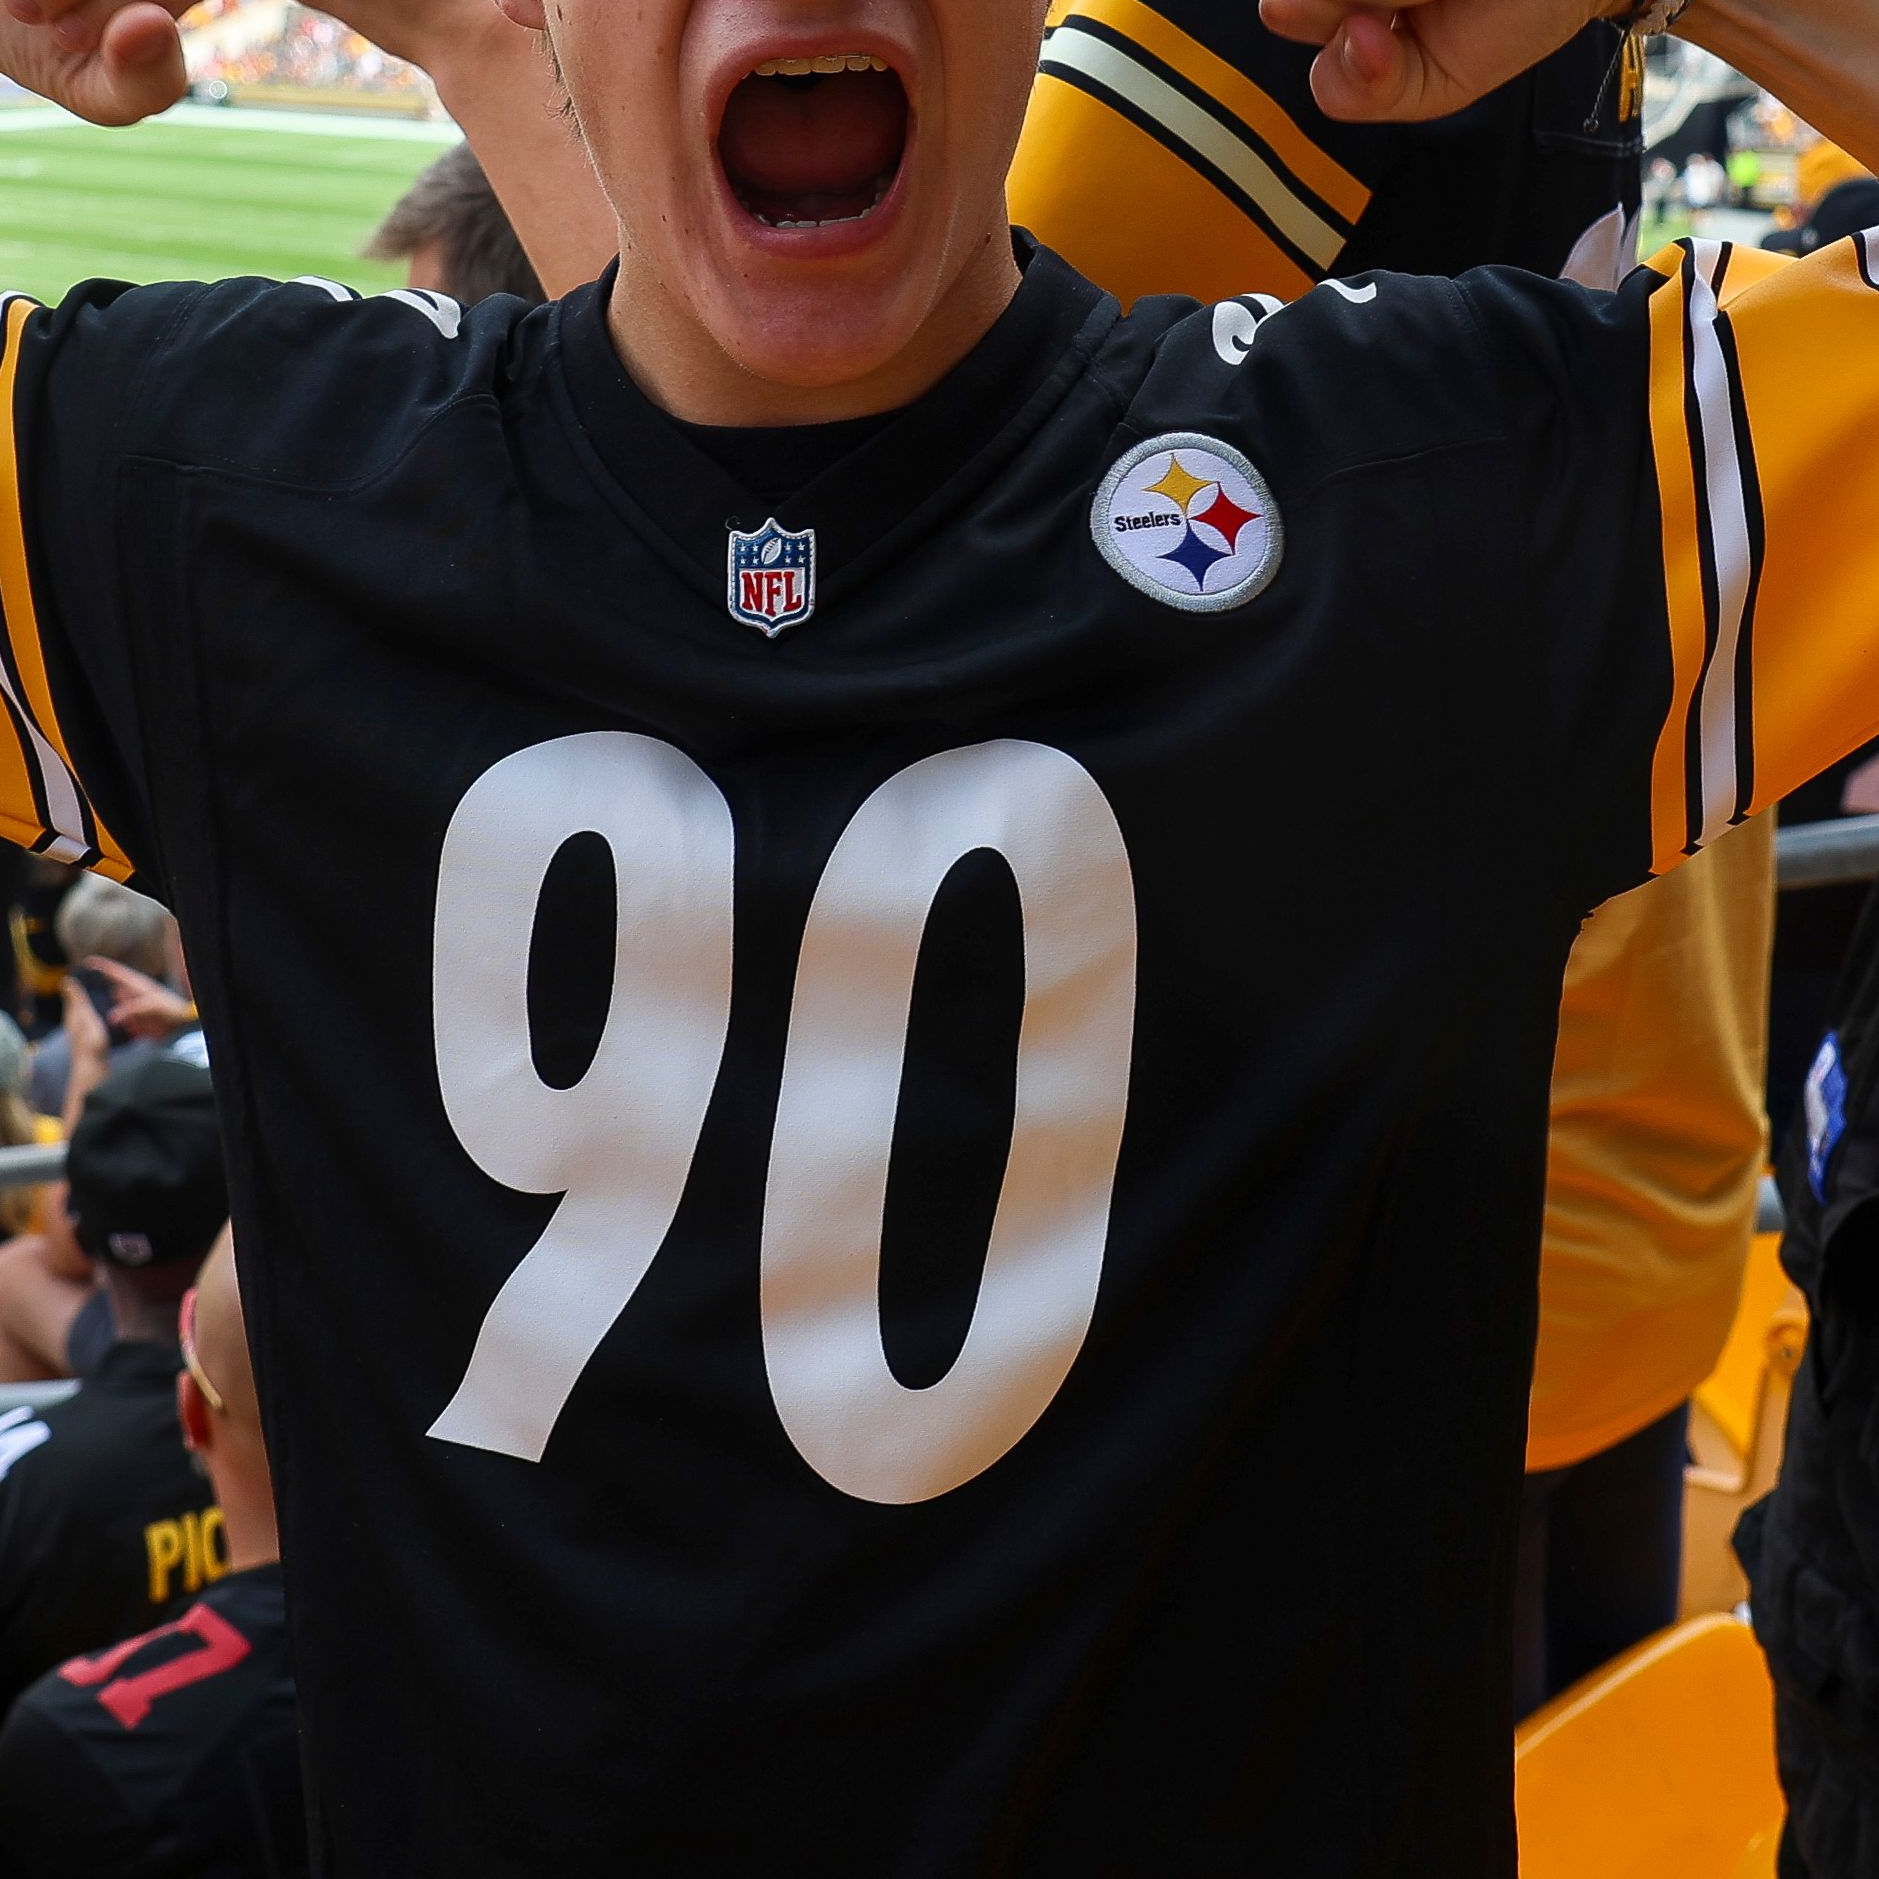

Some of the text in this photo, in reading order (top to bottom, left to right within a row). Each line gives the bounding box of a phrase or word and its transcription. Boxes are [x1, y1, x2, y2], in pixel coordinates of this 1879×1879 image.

[1114, 511, 1181, 532] Steelers
[741, 570, 803, 618] NFL
[425, 730, 1138, 1506] 90
